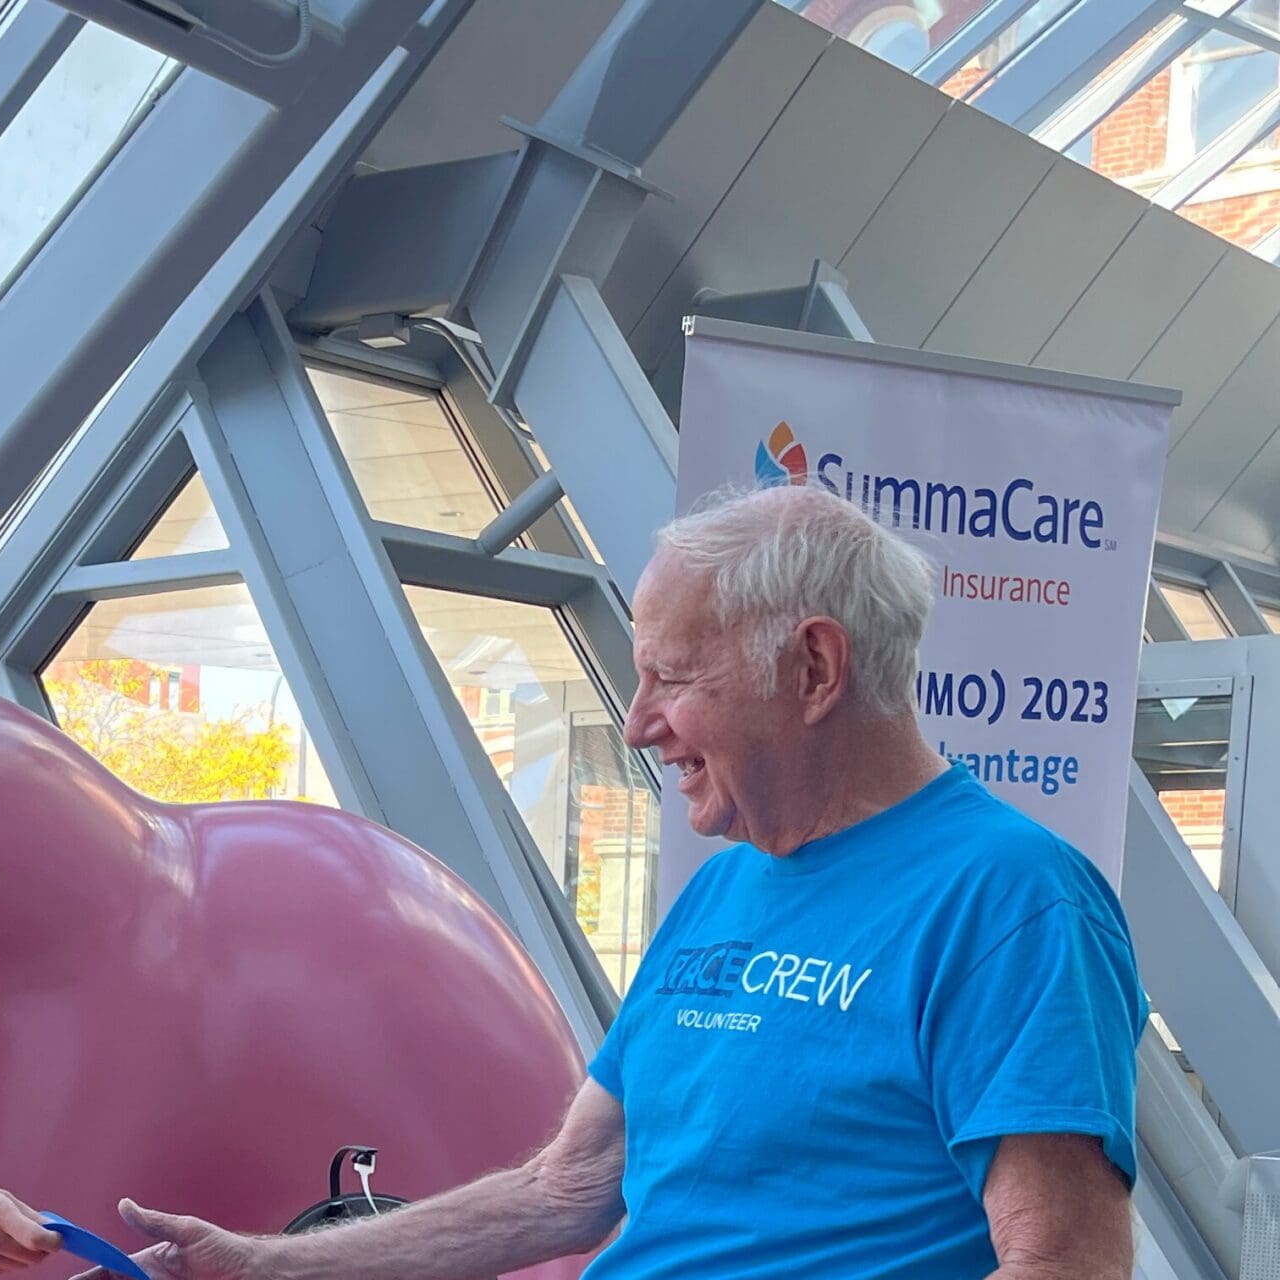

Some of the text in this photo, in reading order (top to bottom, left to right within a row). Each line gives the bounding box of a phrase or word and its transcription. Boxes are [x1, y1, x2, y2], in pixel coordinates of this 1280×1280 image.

[943, 565, 1071, 605] Insurance
[916, 669, 1109, 725] MO) 2023
[676, 1009, 762, 1033] VOLUNTEER
